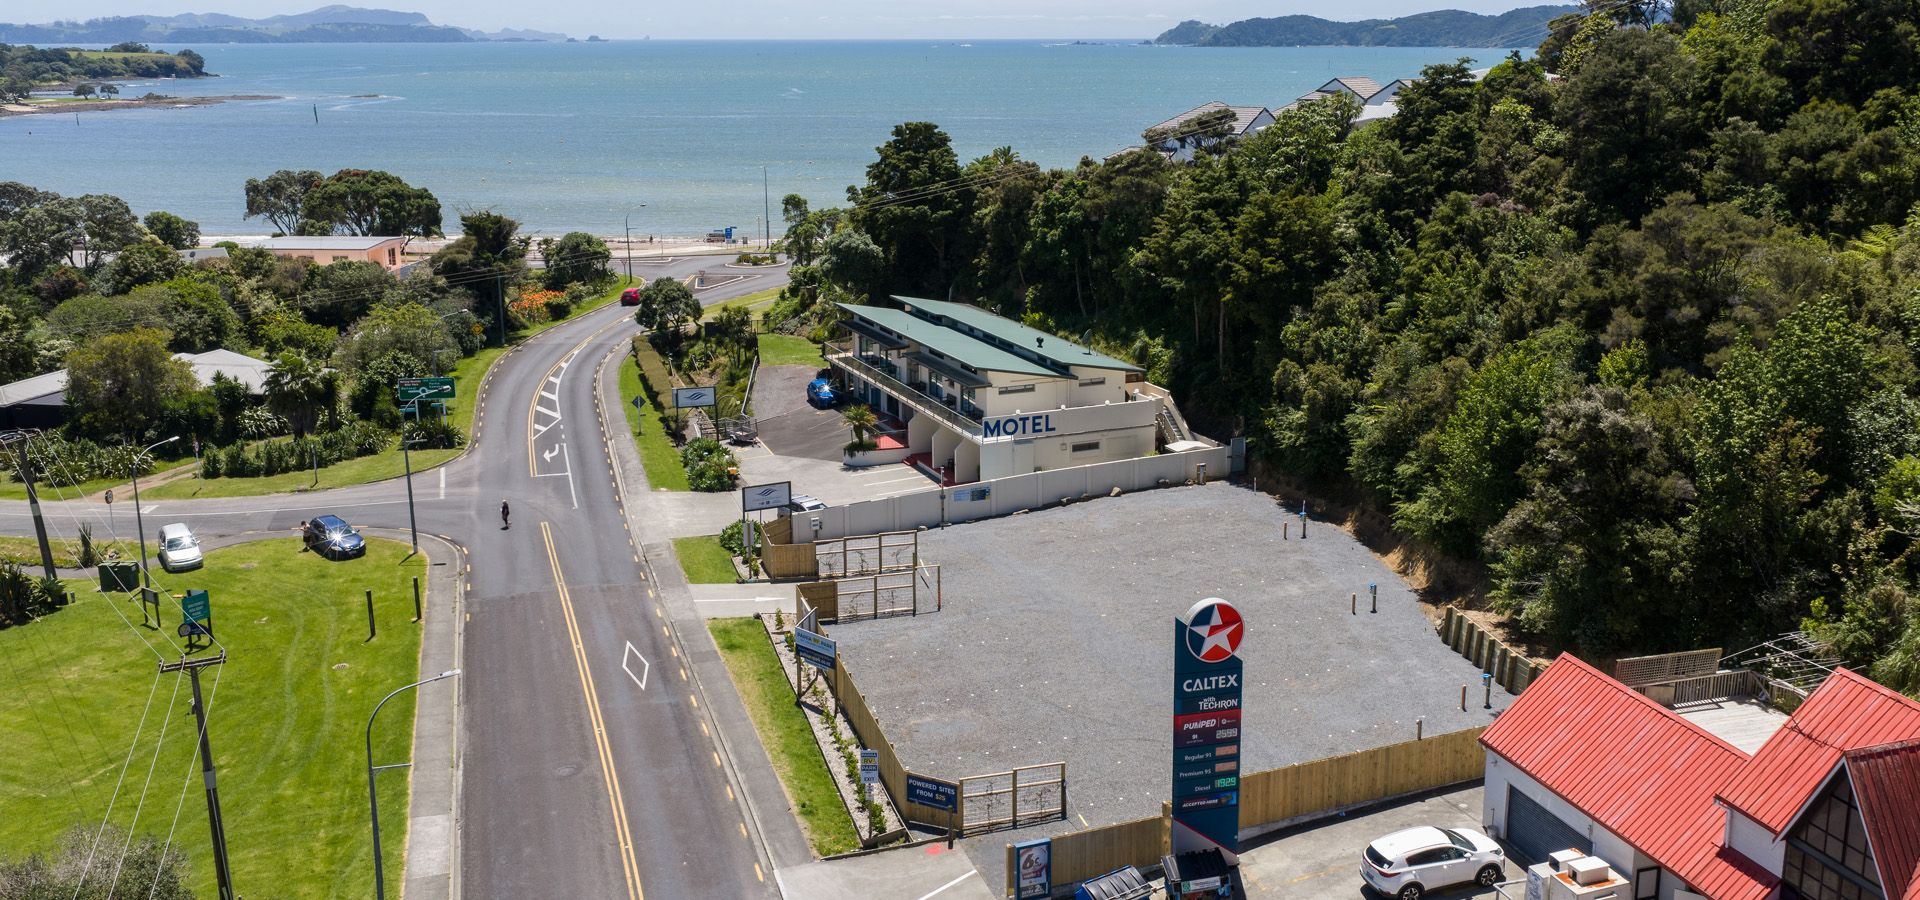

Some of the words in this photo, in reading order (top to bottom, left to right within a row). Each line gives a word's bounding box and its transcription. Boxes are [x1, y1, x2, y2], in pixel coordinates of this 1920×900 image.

[983, 415, 1056, 438] MOTEL
[1183, 674, 1238, 692] CALTEX
[1199, 699, 1238, 710] TECHRON
[1183, 718, 1216, 731] PUMPED
[1184, 753, 1204, 762] Regular
[1179, 769, 1204, 778] Premium
[908, 778, 937, 790] POWERED
[938, 785, 955, 795] SITES
[1194, 783, 1211, 792] Diesel
[916, 789, 934, 798] FROM
